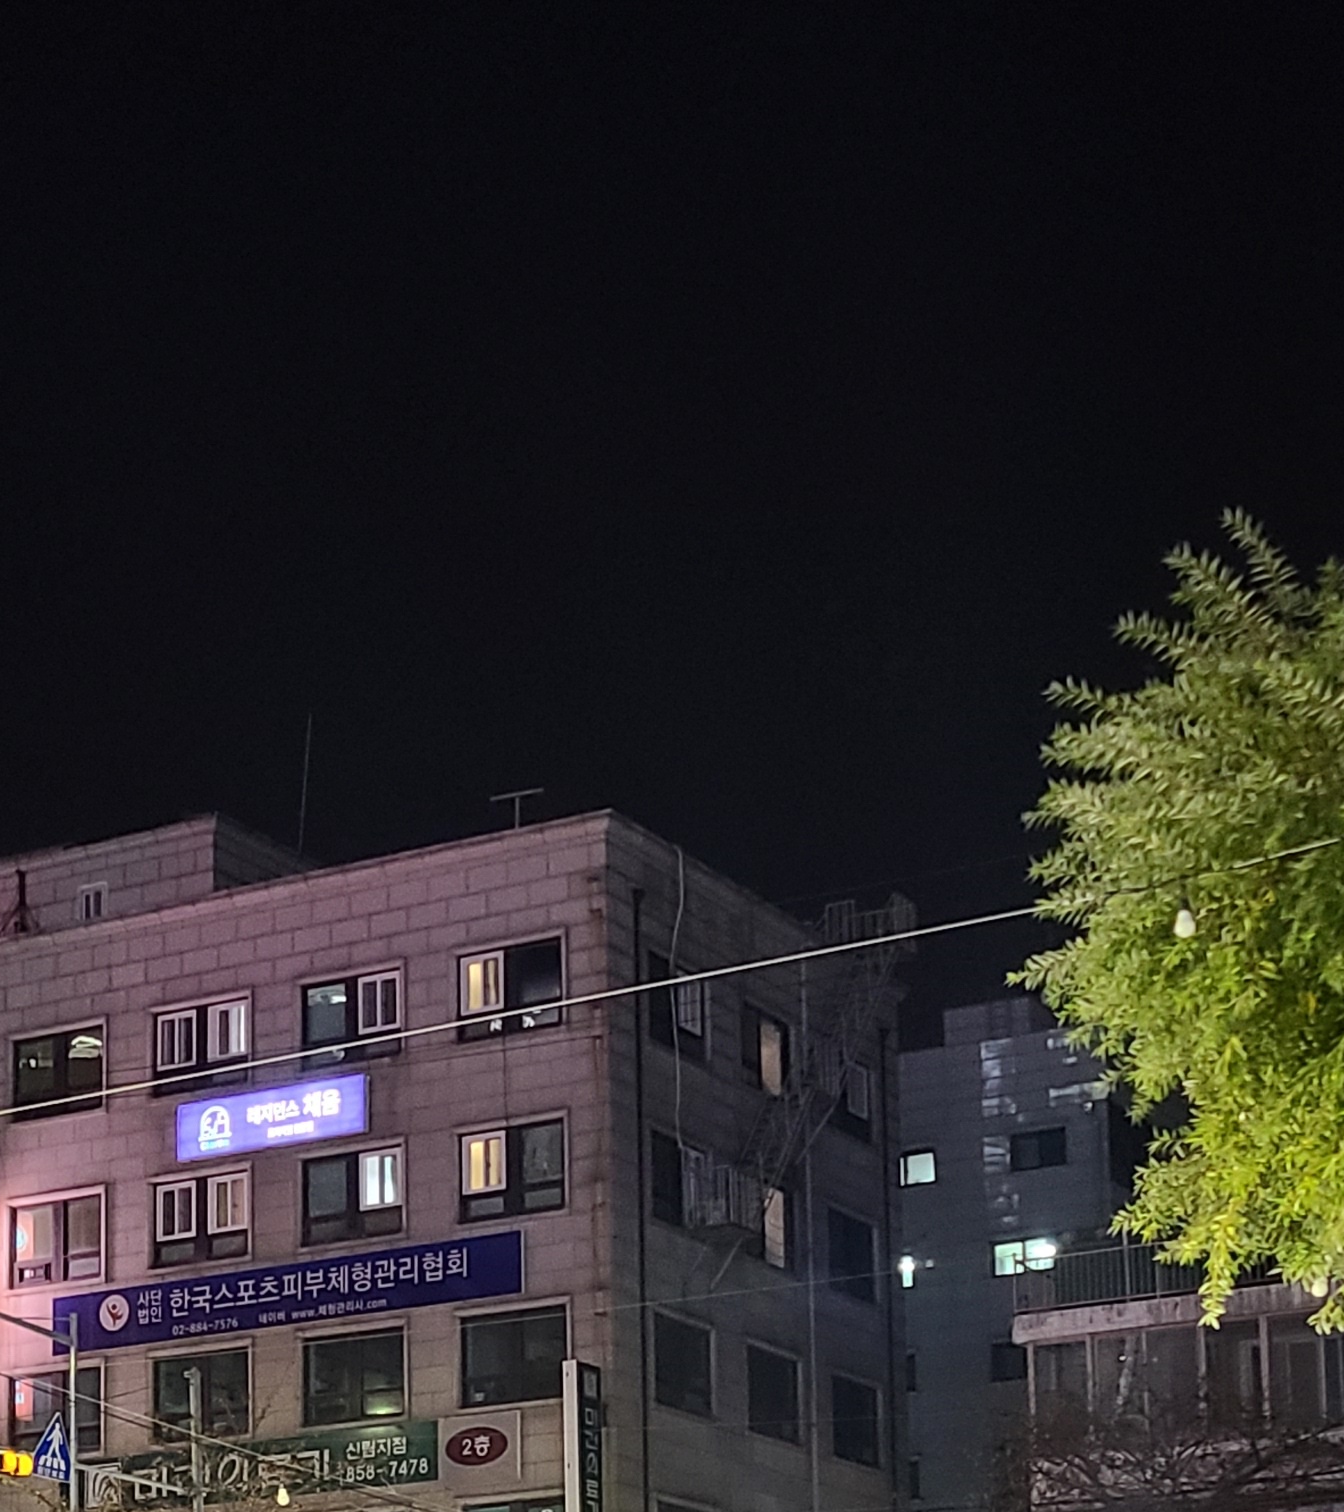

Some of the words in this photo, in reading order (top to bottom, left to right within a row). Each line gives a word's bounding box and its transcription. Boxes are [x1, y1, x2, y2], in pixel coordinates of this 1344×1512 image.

[169, 1247, 468, 1318] 한국스포츠피부체형관리협회
[137, 1289, 163, 1307] 사단
[137, 1307, 163, 1325] 법인
[172, 1317, 239, 1336] 02-884-7576
[258, 1310, 286, 1325] 네이버
[346, 1436, 407, 1461] 신림지점
[461, 1434, 491, 1457] 2층
[346, 1458, 429, 1483] 858-7478
